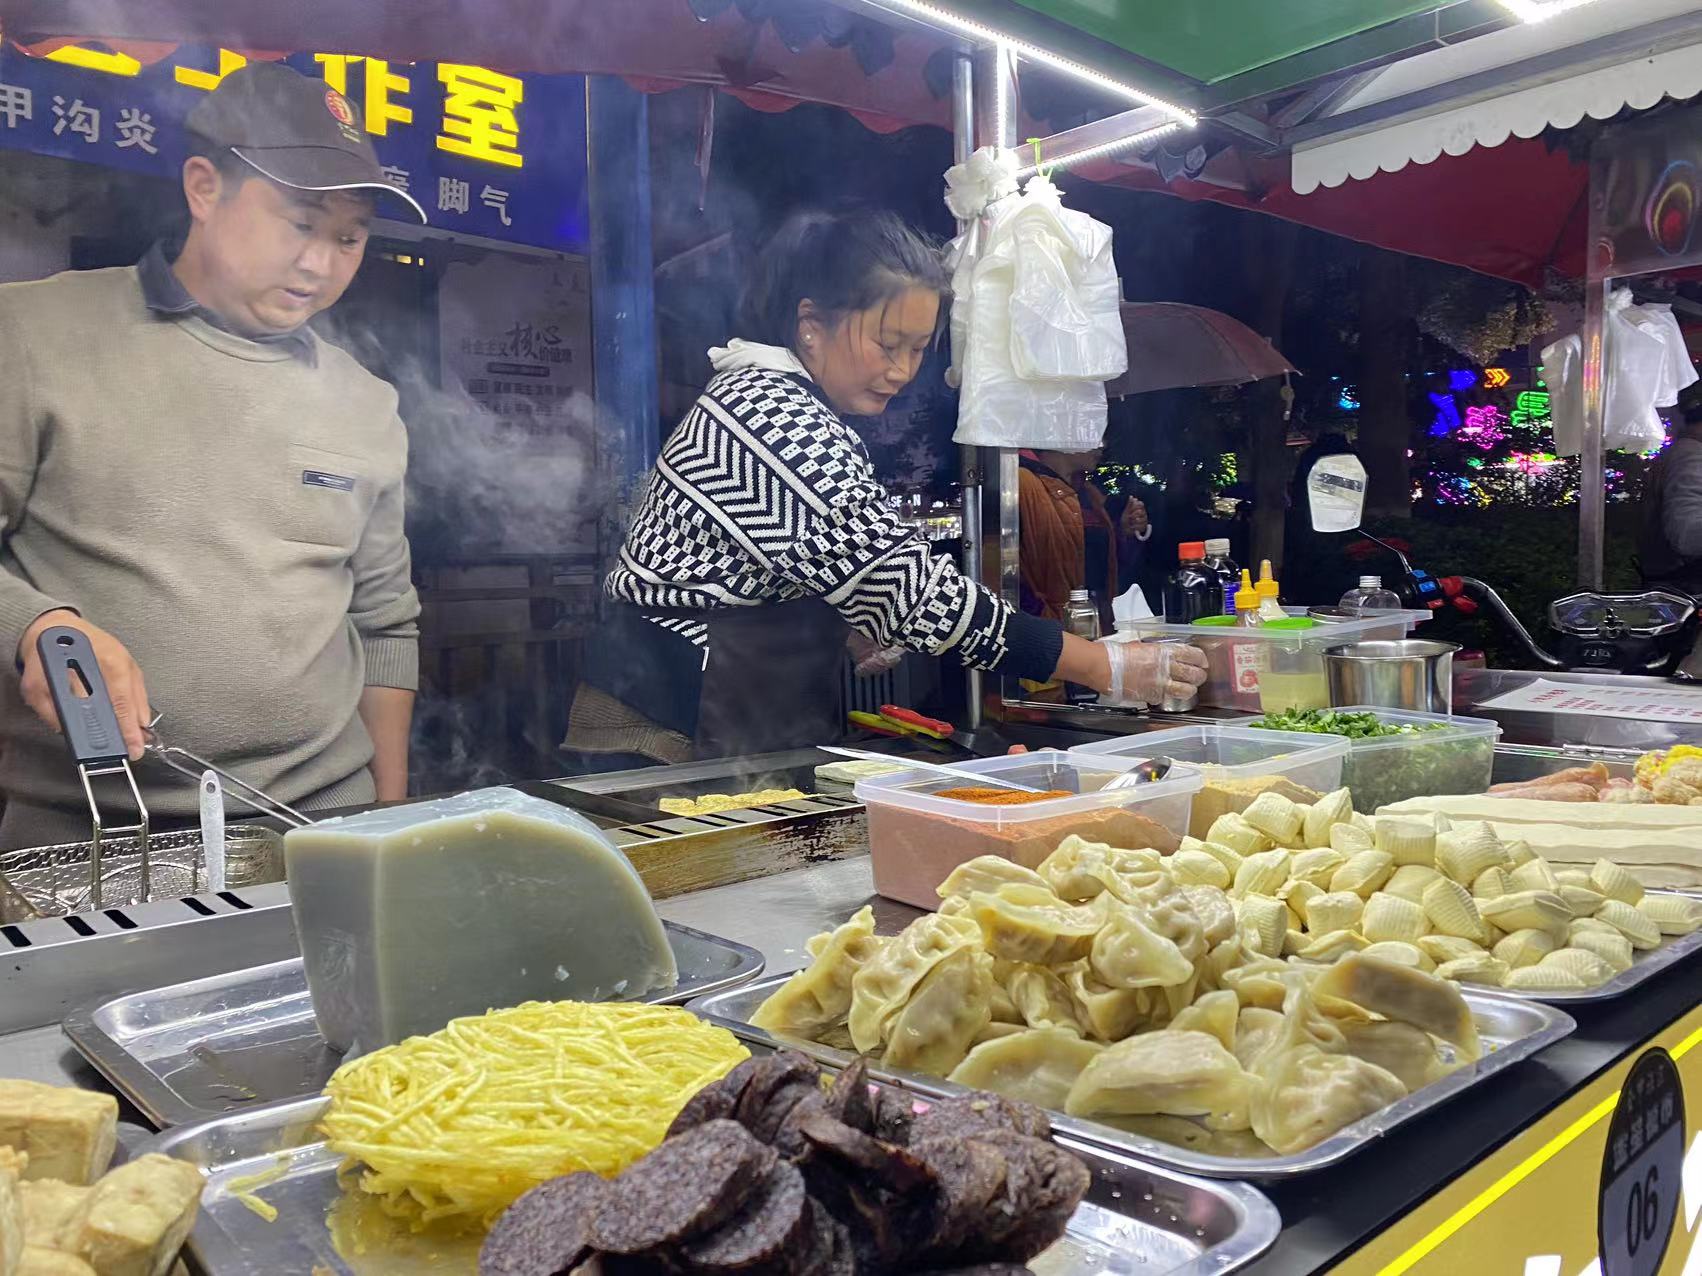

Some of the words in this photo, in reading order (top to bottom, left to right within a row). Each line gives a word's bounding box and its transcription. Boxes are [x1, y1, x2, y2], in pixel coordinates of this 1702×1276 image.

[0, 83, 158, 155] 甲沟炎
[437, 177, 512, 226] 脚气
[1627, 1165, 1659, 1258] 06
